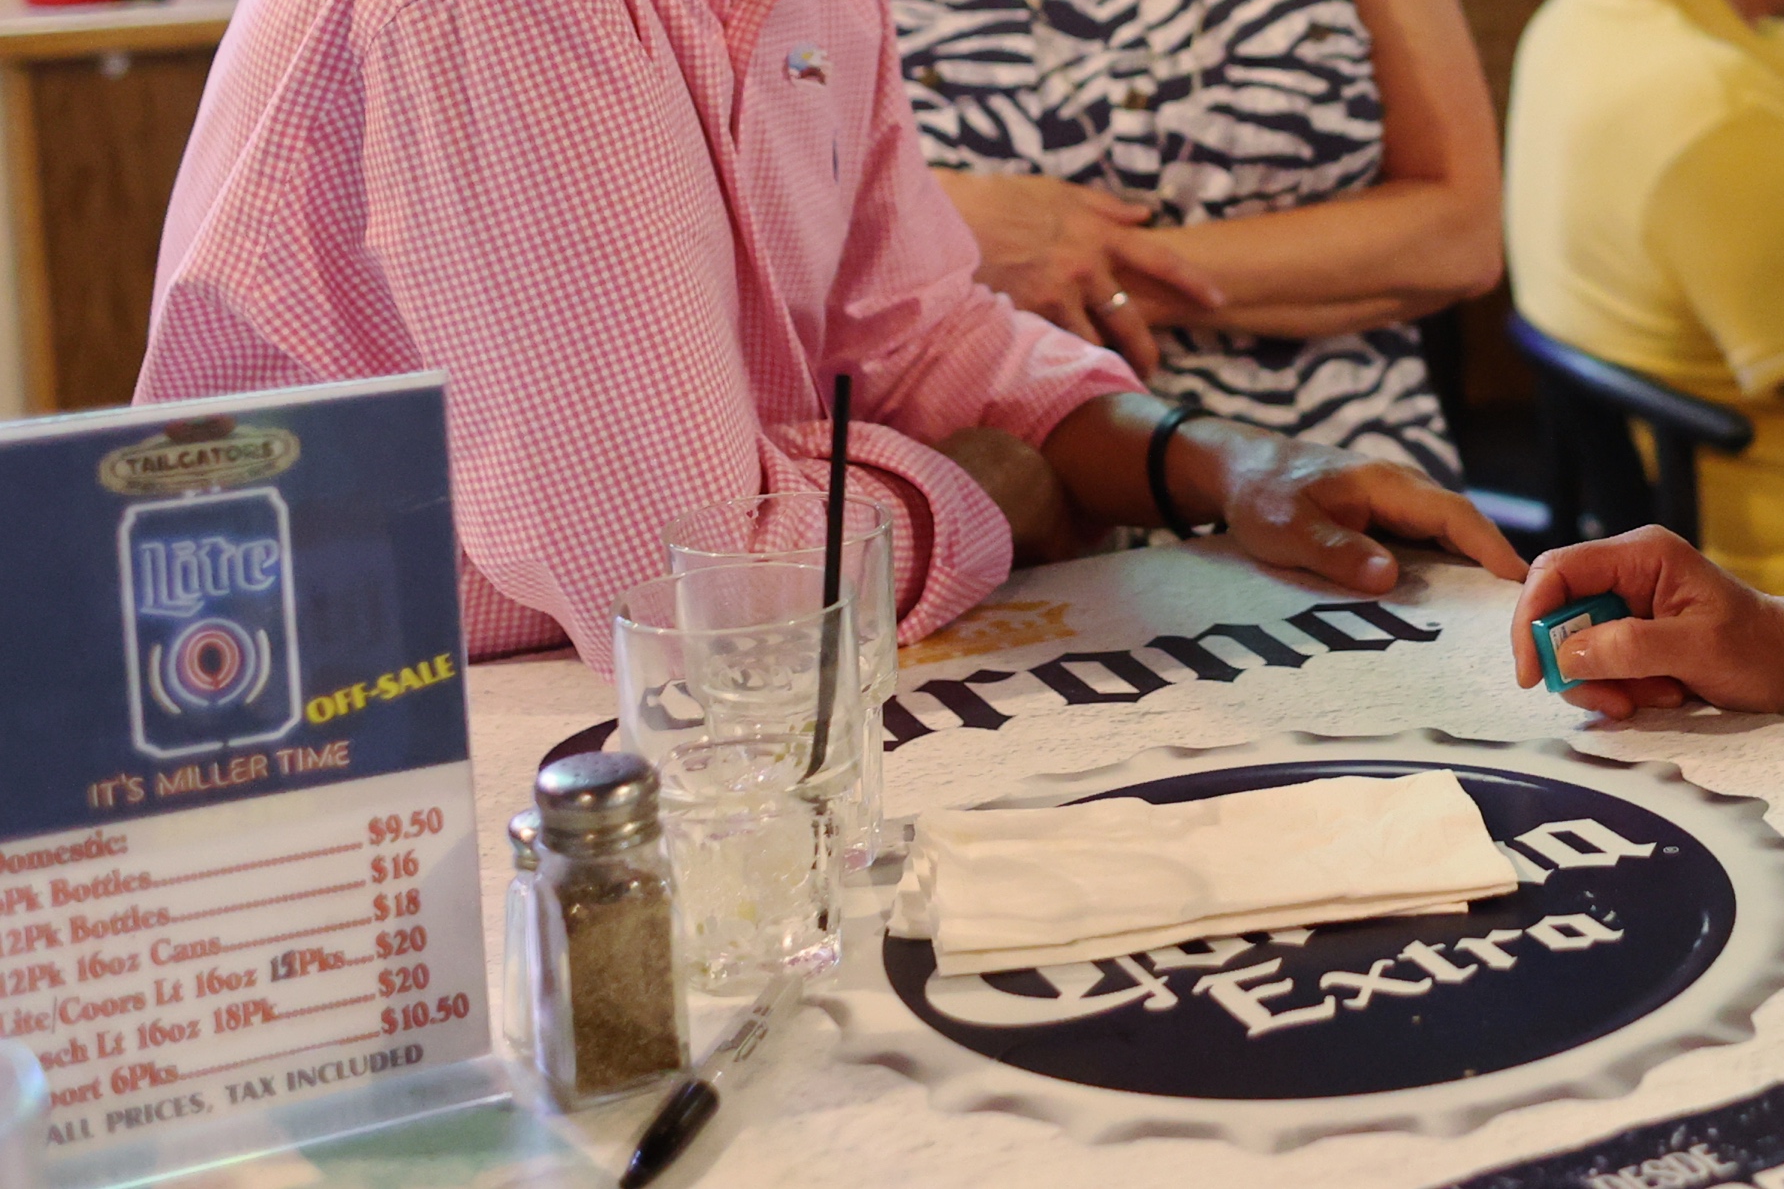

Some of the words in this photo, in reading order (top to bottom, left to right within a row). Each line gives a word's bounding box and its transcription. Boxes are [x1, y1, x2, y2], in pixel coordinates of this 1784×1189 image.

[139, 536, 280, 617] Lite
[305, 653, 456, 725] OFF-SALE
[88, 772, 145, 808] IT'S
[156, 754, 268, 796] MILLER
[276, 740, 351, 775] TIME
[50, 868, 152, 907] Bottles
[368, 806, 444, 847] $9.50
[69, 905, 171, 945] Bottles
[370, 849, 420, 884] $16
[77, 951, 141, 982] 16oz
[150, 937, 222, 966] Cans
[373, 888, 421, 922] $18
[154, 978, 184, 1006] Lt
[195, 967, 259, 998] 16oz
[375, 925, 427, 960] $20
[1192, 912, 1625, 1038] Extra
[97, 1029, 127, 1059] Lt
[137, 1019, 202, 1051] 16oz
[378, 962, 430, 998] $20
[381, 991, 470, 1036] $10.50
[47, 1117, 95, 1147] ALL
[225, 1076, 277, 1105] TAX
[286, 1043, 425, 1092] INCLUDED
